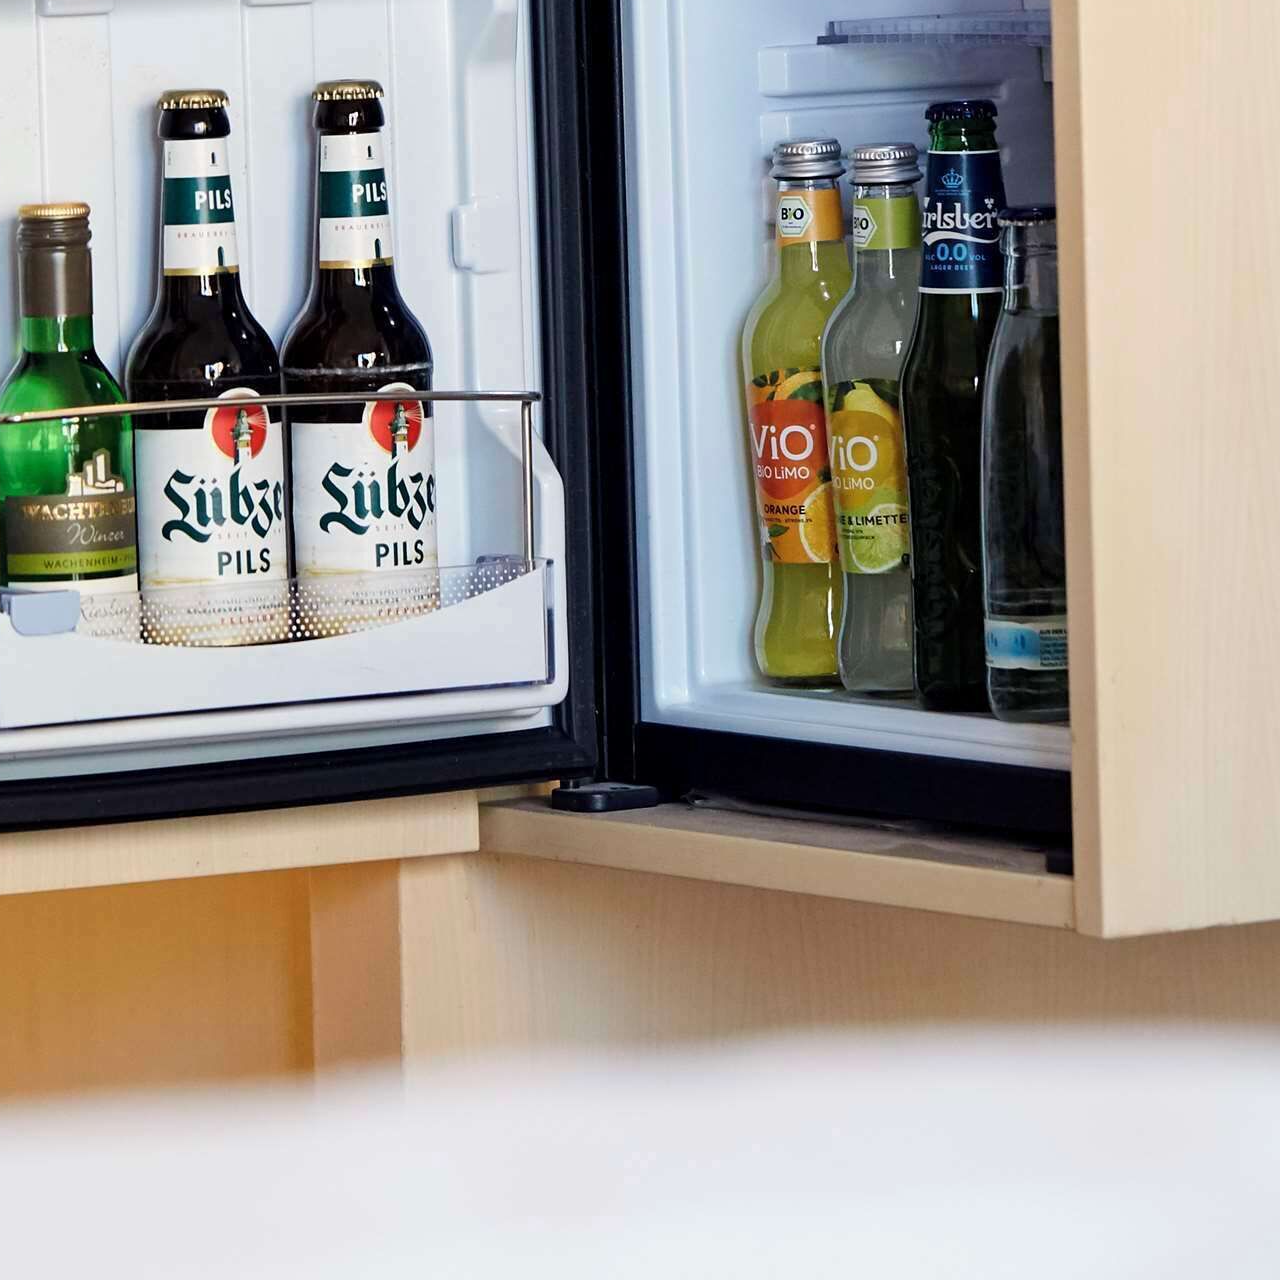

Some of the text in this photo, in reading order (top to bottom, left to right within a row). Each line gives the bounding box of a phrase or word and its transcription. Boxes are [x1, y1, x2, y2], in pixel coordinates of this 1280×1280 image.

[194, 189, 232, 210] PILS
[351, 181, 387, 204] PILS
[936, 242, 968, 262] 0.0
[764, 503, 807, 516] ORANGE
[855, 513, 908, 526] LIMETTE
[217, 547, 271, 577] PILS
[375, 539, 425, 568] PILS
